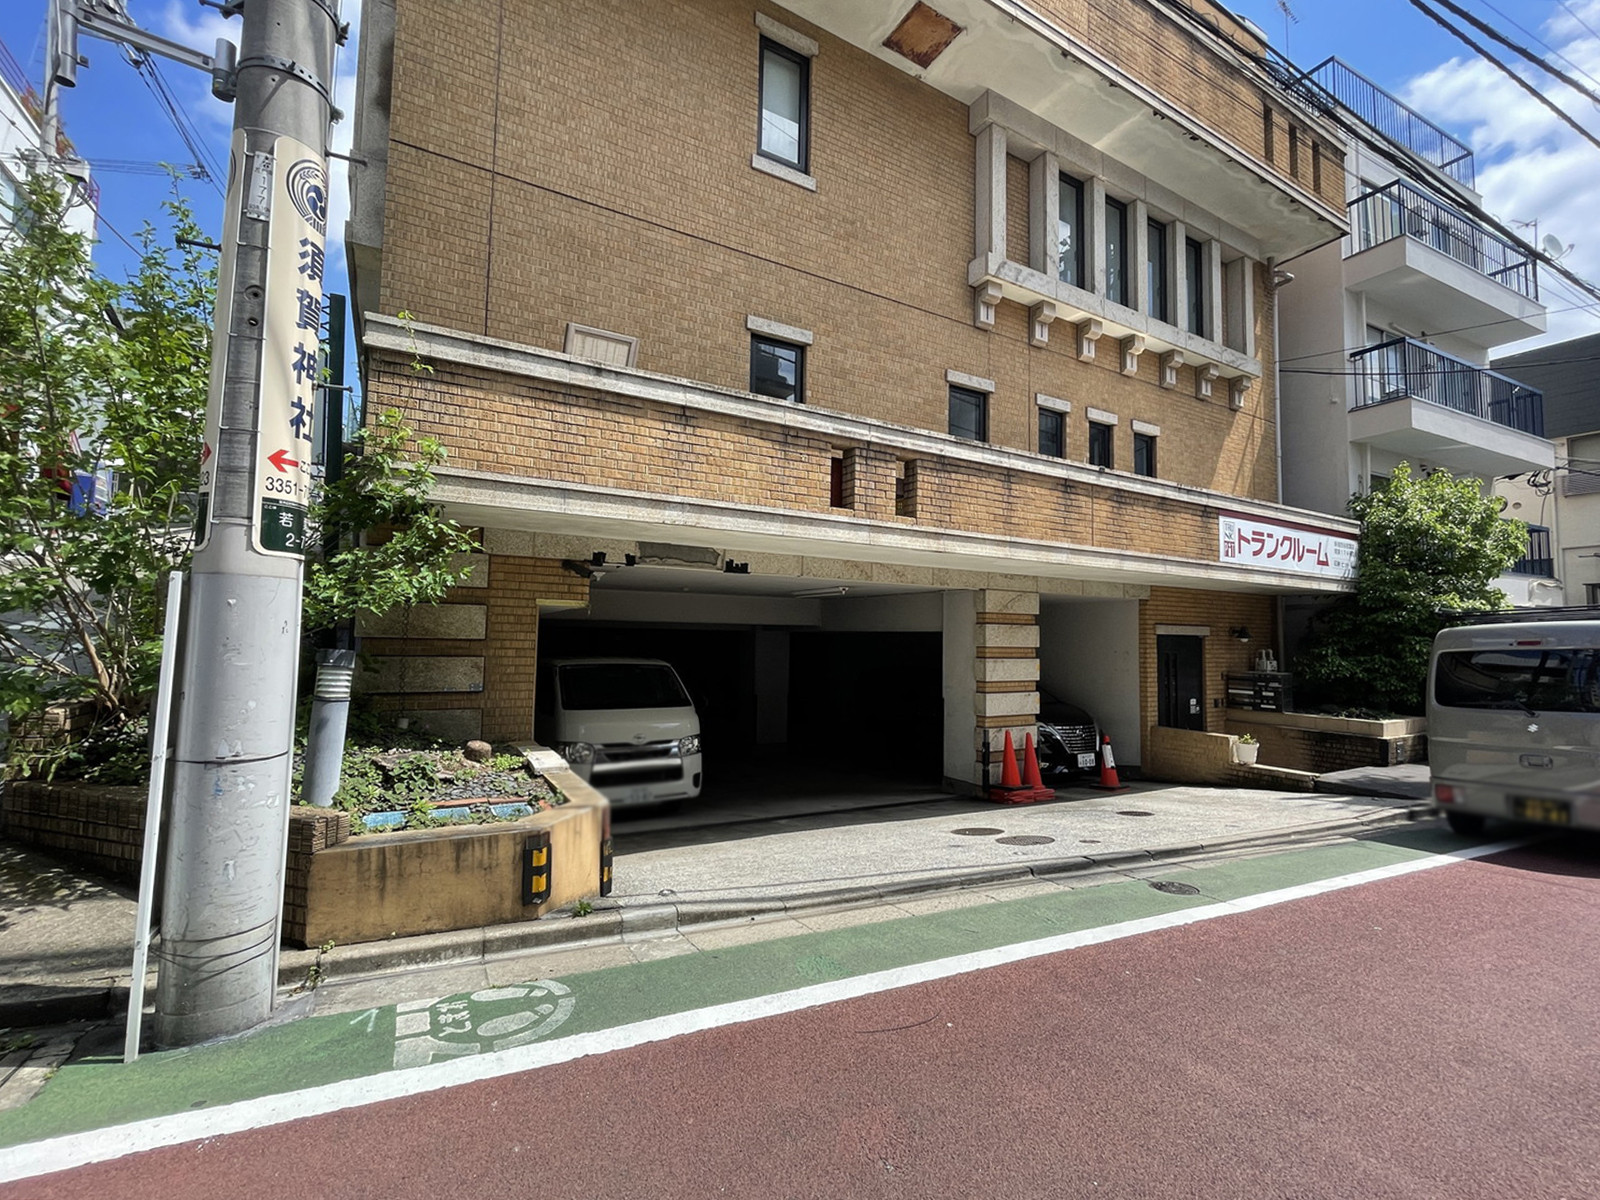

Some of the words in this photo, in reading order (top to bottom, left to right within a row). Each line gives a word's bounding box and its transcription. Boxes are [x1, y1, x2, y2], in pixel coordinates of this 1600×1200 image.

[290, 237, 325, 443] 須賀神社
[1237, 527, 1330, 567] トランクルーム
